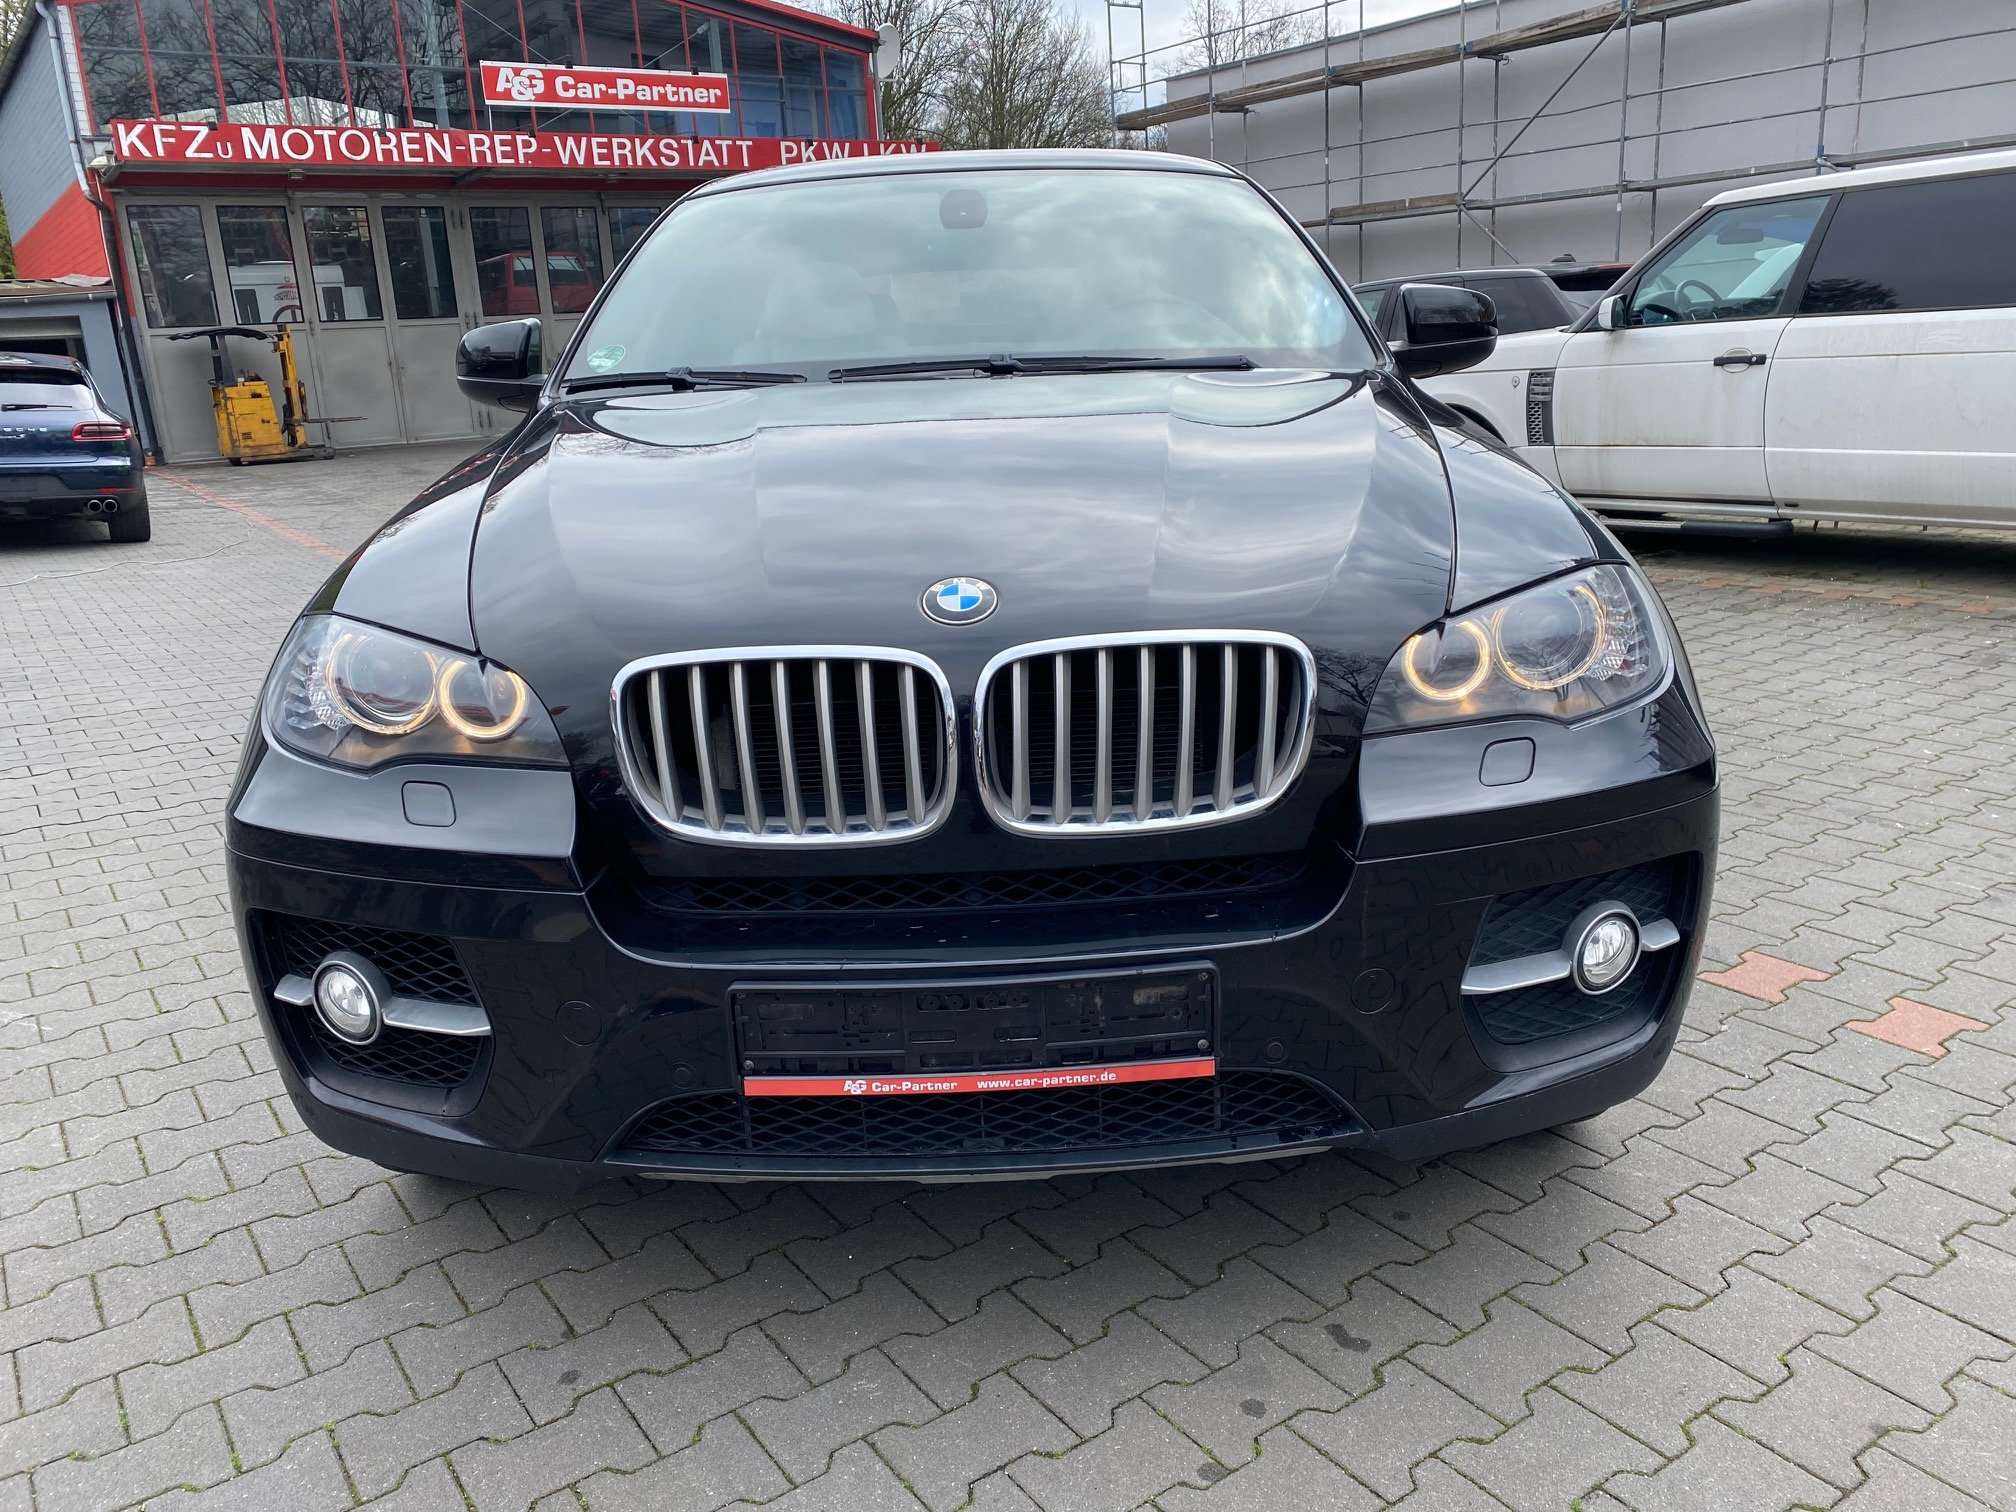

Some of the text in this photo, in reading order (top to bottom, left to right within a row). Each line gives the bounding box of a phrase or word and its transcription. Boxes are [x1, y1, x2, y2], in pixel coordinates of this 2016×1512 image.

[555, 75, 721, 103] Car-Partner
[780, 140, 850, 165] PKW
[872, 1081, 958, 1092] Car-Partner
[976, 1071, 1117, 1088] www.car-partner.de
